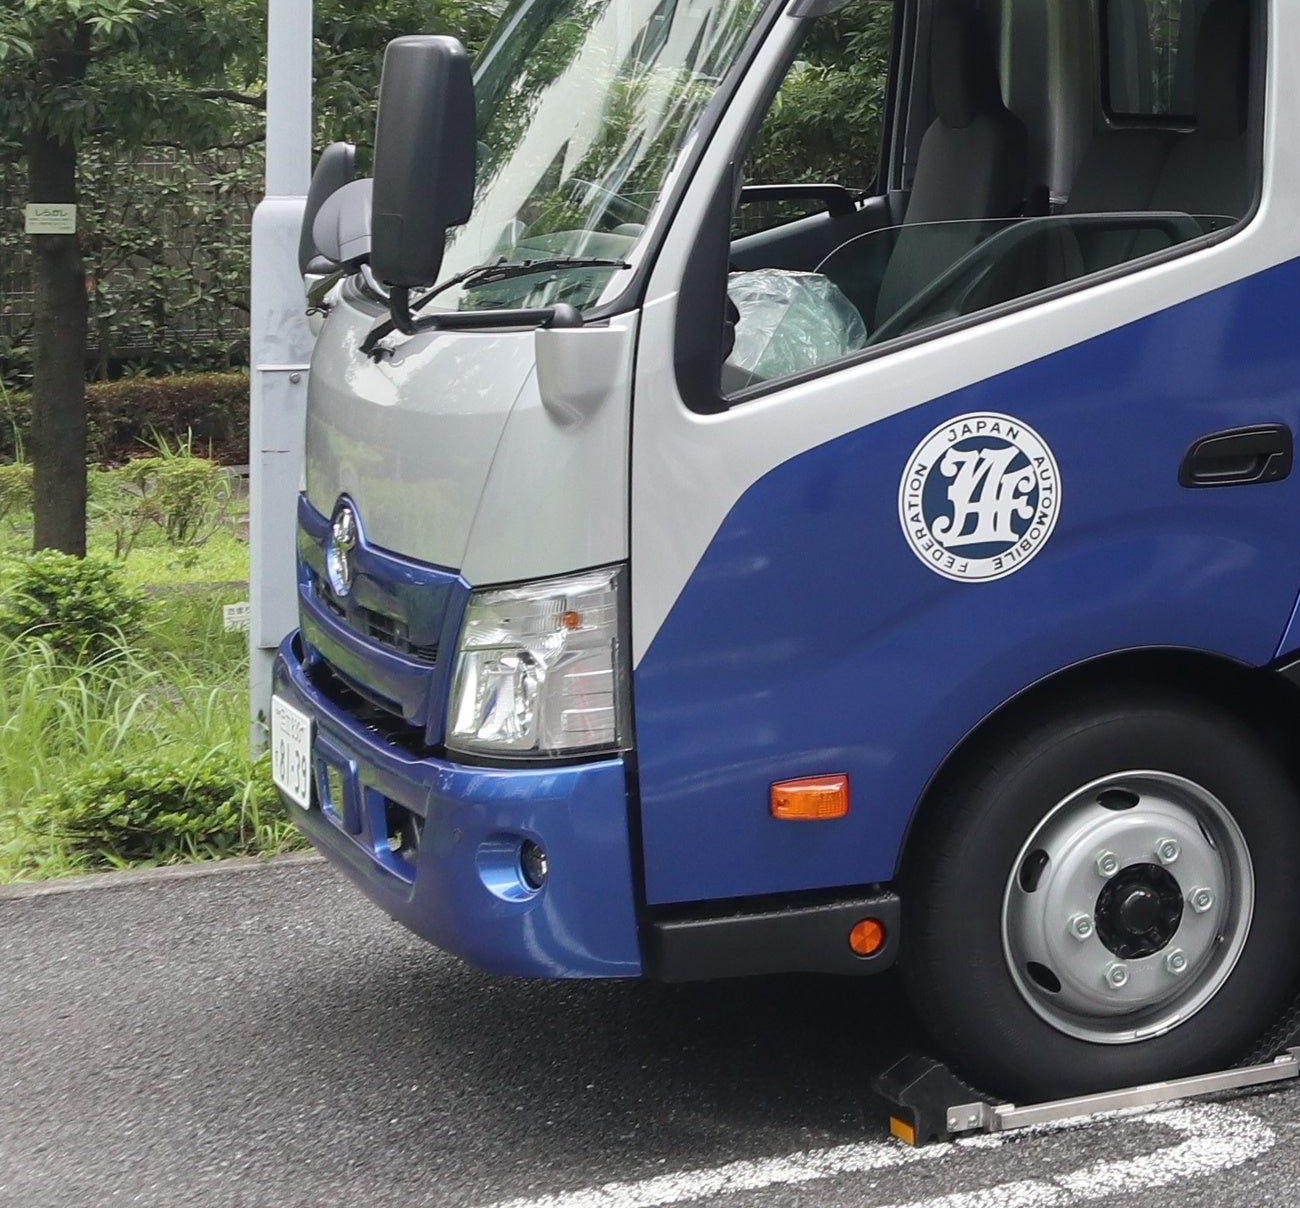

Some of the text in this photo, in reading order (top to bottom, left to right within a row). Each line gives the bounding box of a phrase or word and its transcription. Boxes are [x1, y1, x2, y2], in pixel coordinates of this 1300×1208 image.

[947, 420, 1020, 443] JAPAN
[908, 463, 969, 573] FEDERATION
[992, 455, 1053, 571] AUTOMOBILE
